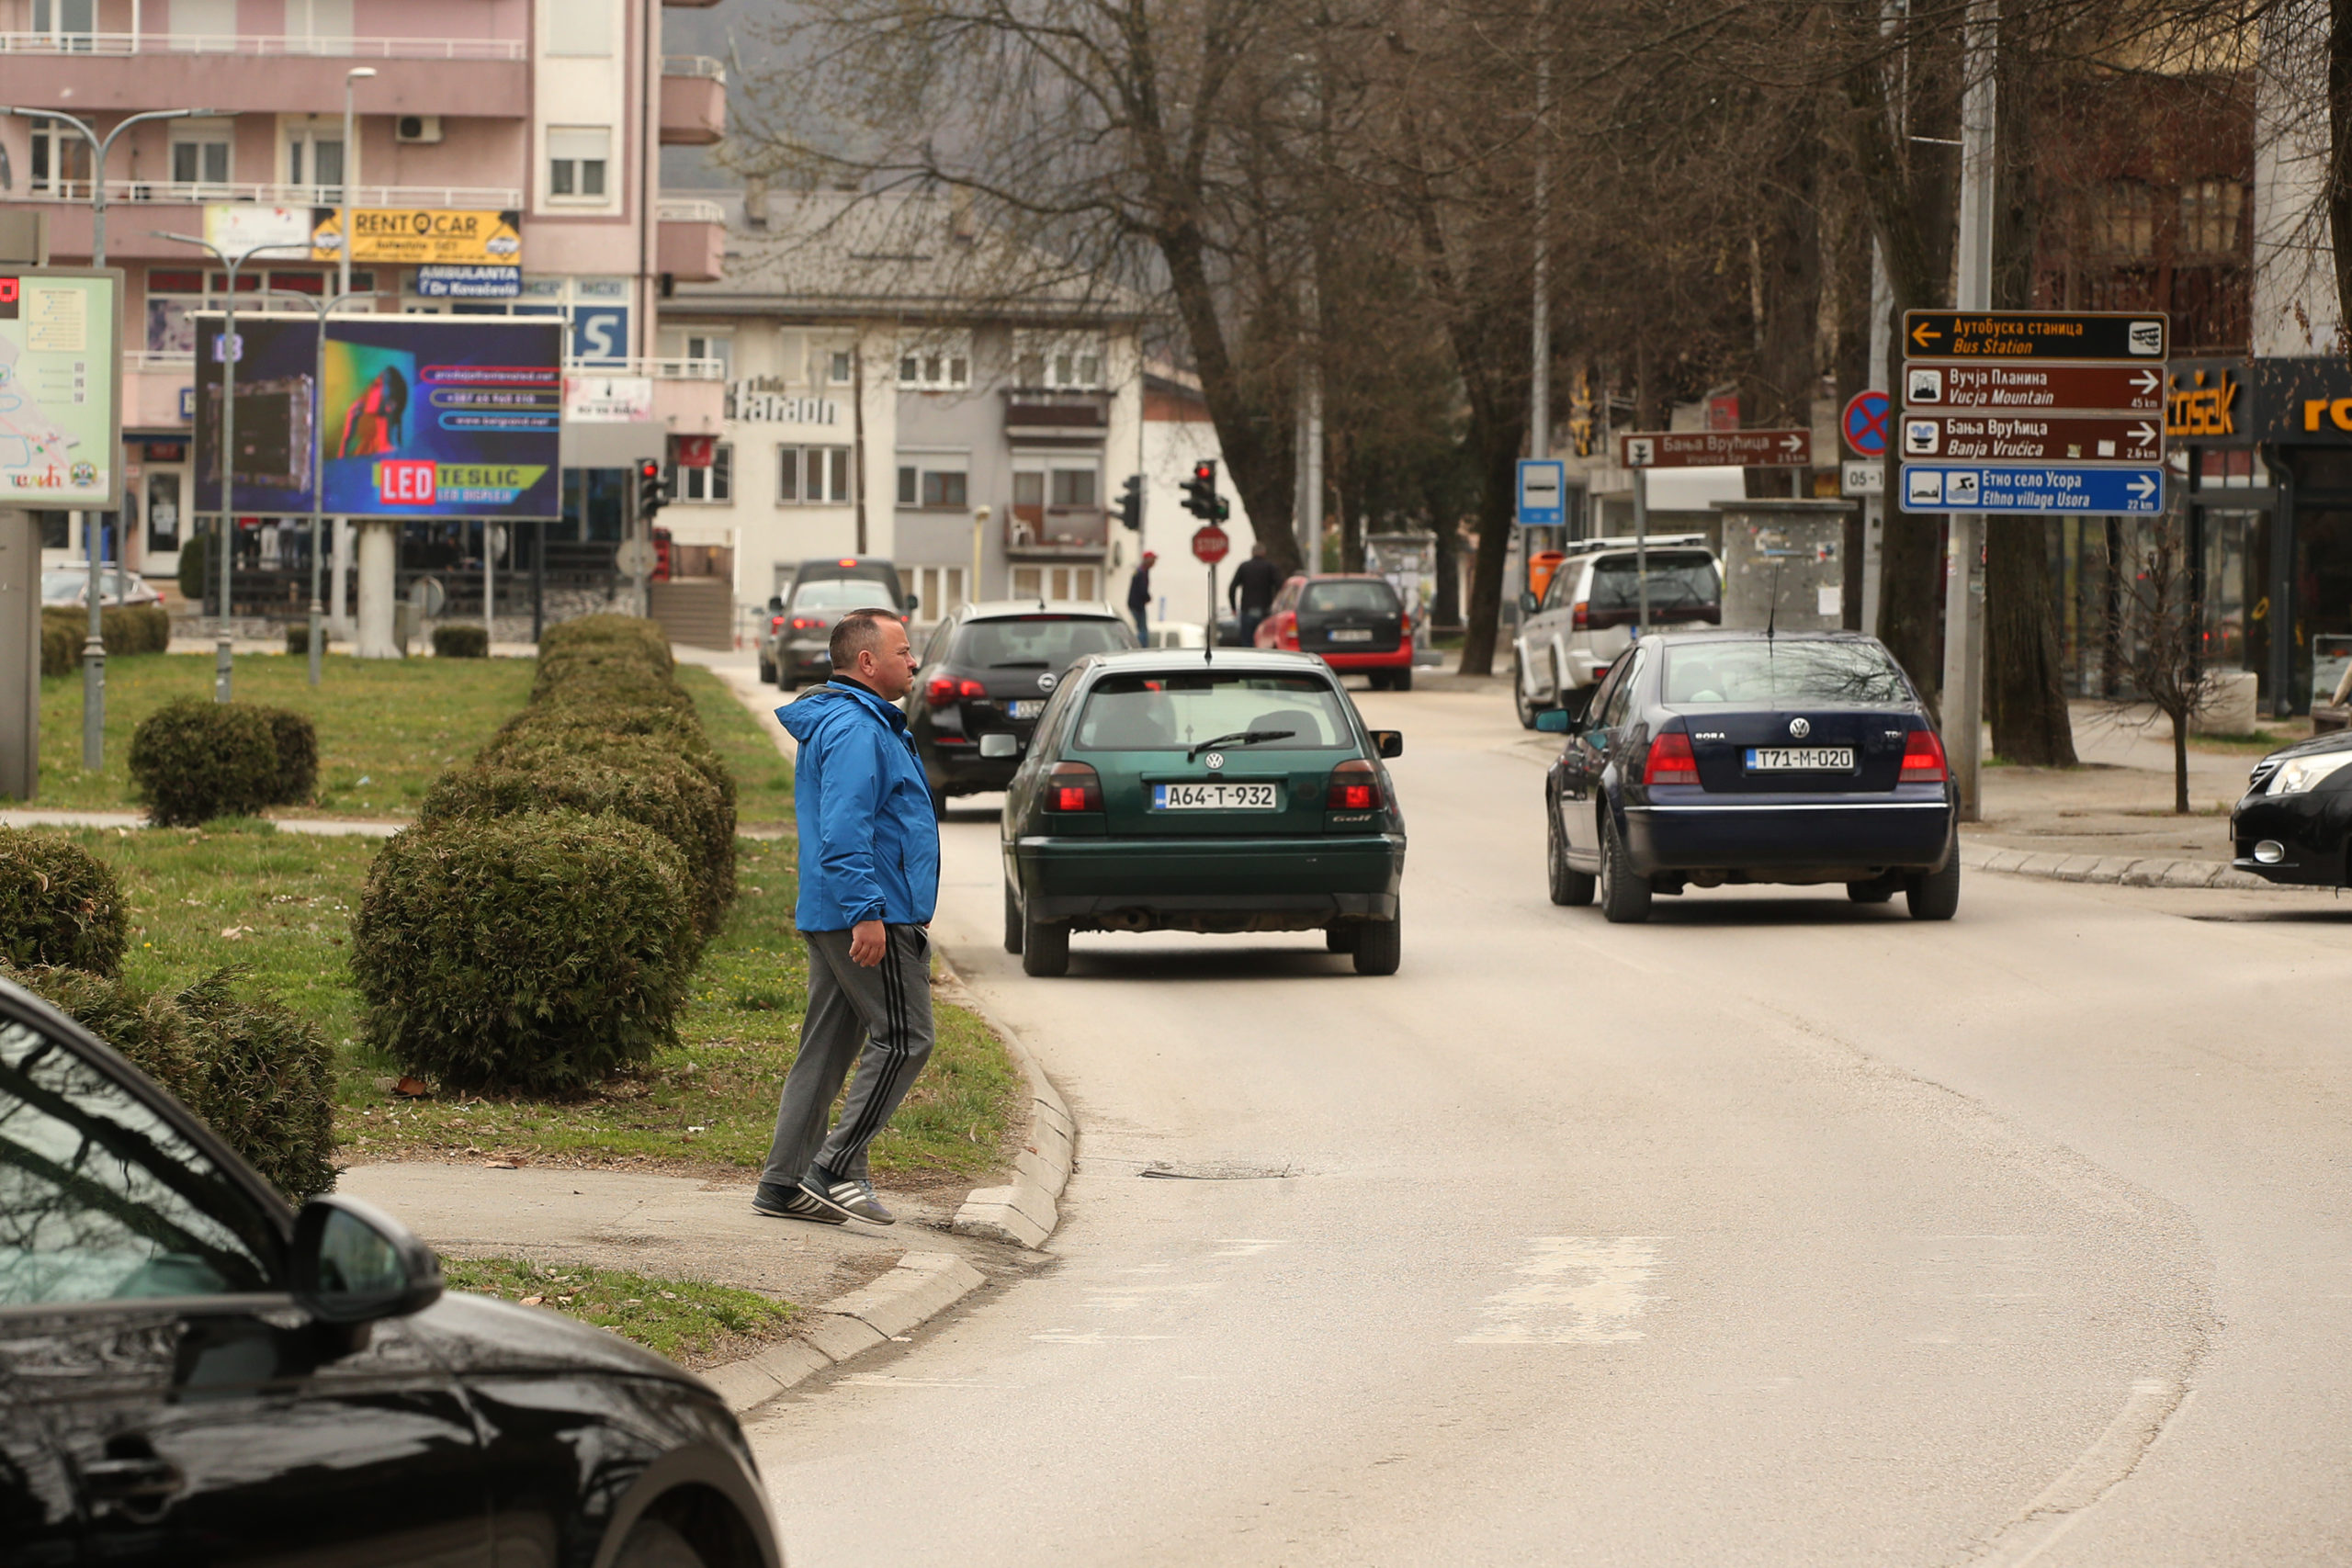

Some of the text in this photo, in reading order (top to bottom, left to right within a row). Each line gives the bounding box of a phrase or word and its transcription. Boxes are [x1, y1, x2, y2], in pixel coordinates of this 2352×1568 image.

[356, 214, 477, 231] RENT CAR
[420, 266, 518, 280] AMBULANTA
[1953, 318, 2083, 336] Аутобуска станица
[1953, 338, 2032, 355] Bus Station
[1950, 368, 2048, 388] Вучја Планина
[1949, 388, 2054, 408] Vucja Mountain
[2131, 397, 2158, 408] 45 km
[1946, 419, 2048, 438] Бања Врућица
[1663, 434, 1770, 453] Бања Врућица
[1947, 439, 2044, 458] Banja Vrućica
[2144, 448, 2157, 458] km
[383, 466, 434, 500] LED
[1982, 469, 2082, 491] Етно село Усора
[1982, 491, 2090, 510] Ethno village Usora
[2127, 500, 2154, 511] 22 km
[1197, 537, 1227, 552] STOP
[1758, 750, 1850, 768] T71-M-020
[1169, 787, 1272, 806] A64-T-932
